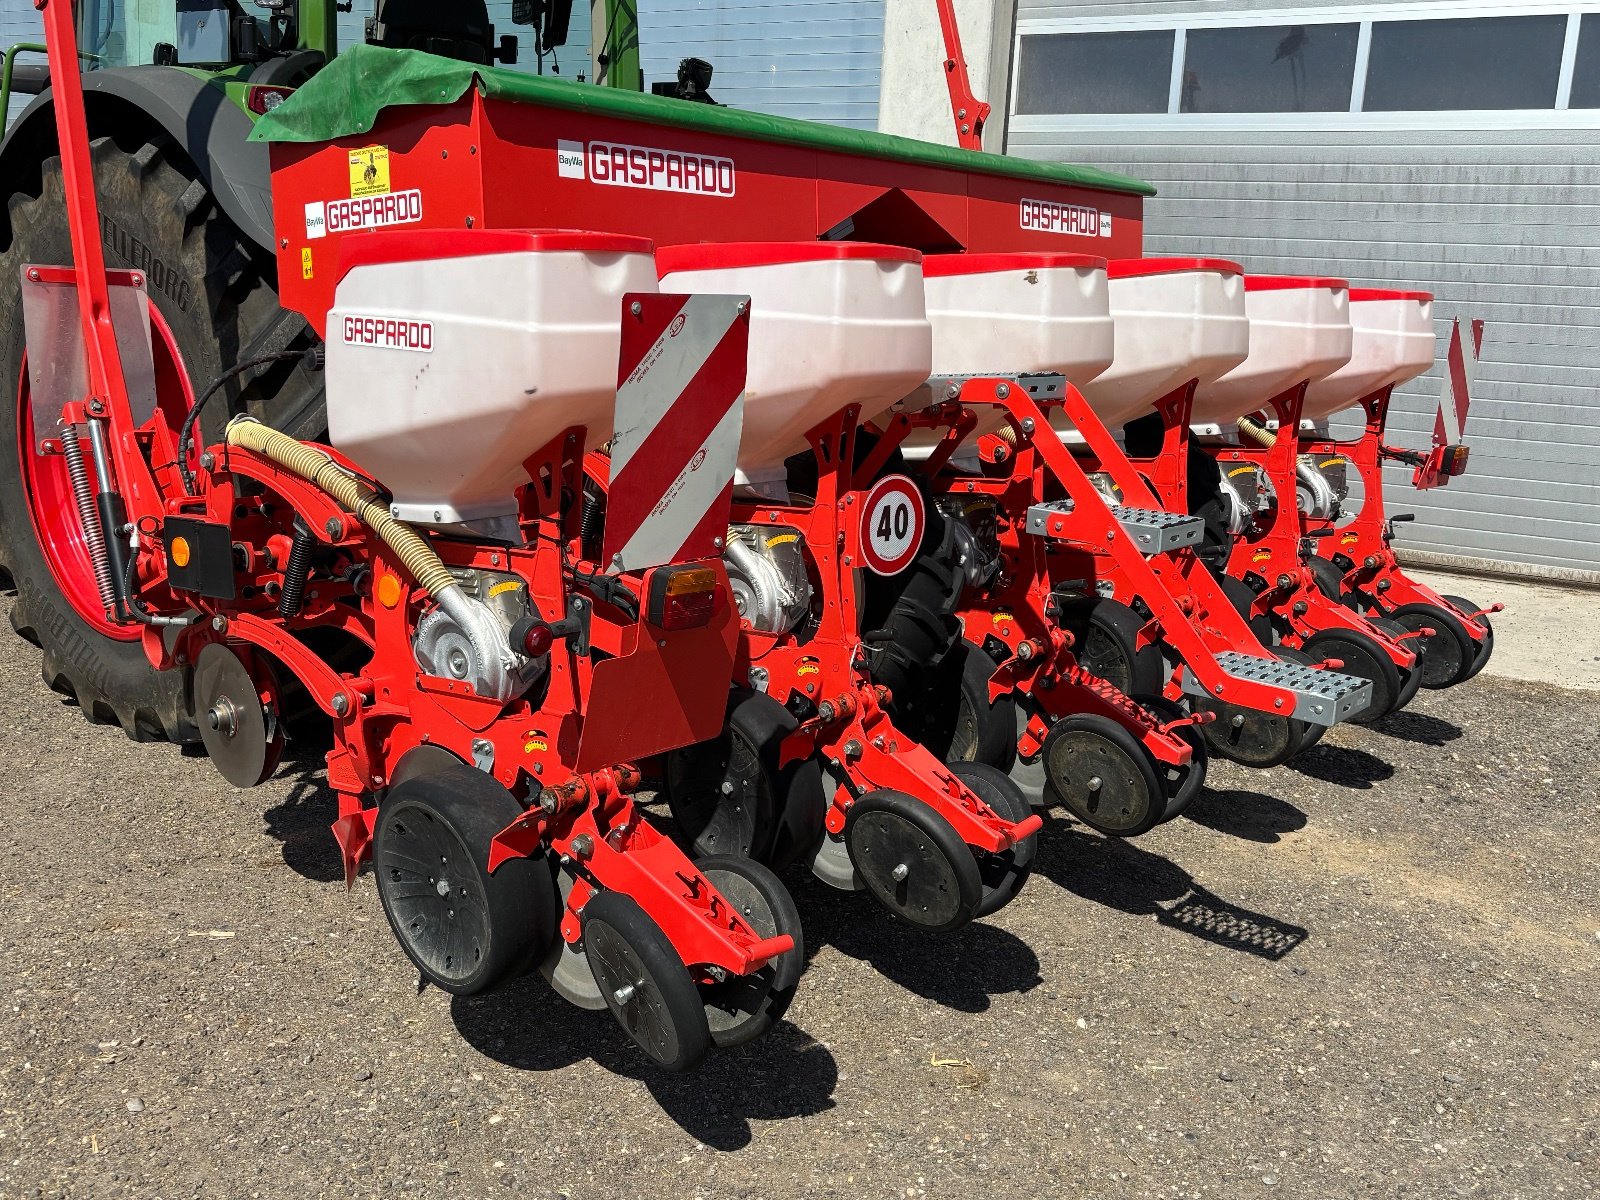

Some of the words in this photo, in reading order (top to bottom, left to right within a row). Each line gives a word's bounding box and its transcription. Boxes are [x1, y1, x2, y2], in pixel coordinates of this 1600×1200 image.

[558, 154, 583, 167] BayWa
[591, 144, 733, 194] GASPARDO
[328, 192, 421, 230] GASPARDO
[1021, 200, 1097, 234] GASPARDO
[102, 214, 192, 313] ELLEBORG
[344, 316, 432, 349] GASPARDO
[876, 502, 909, 542] 40
